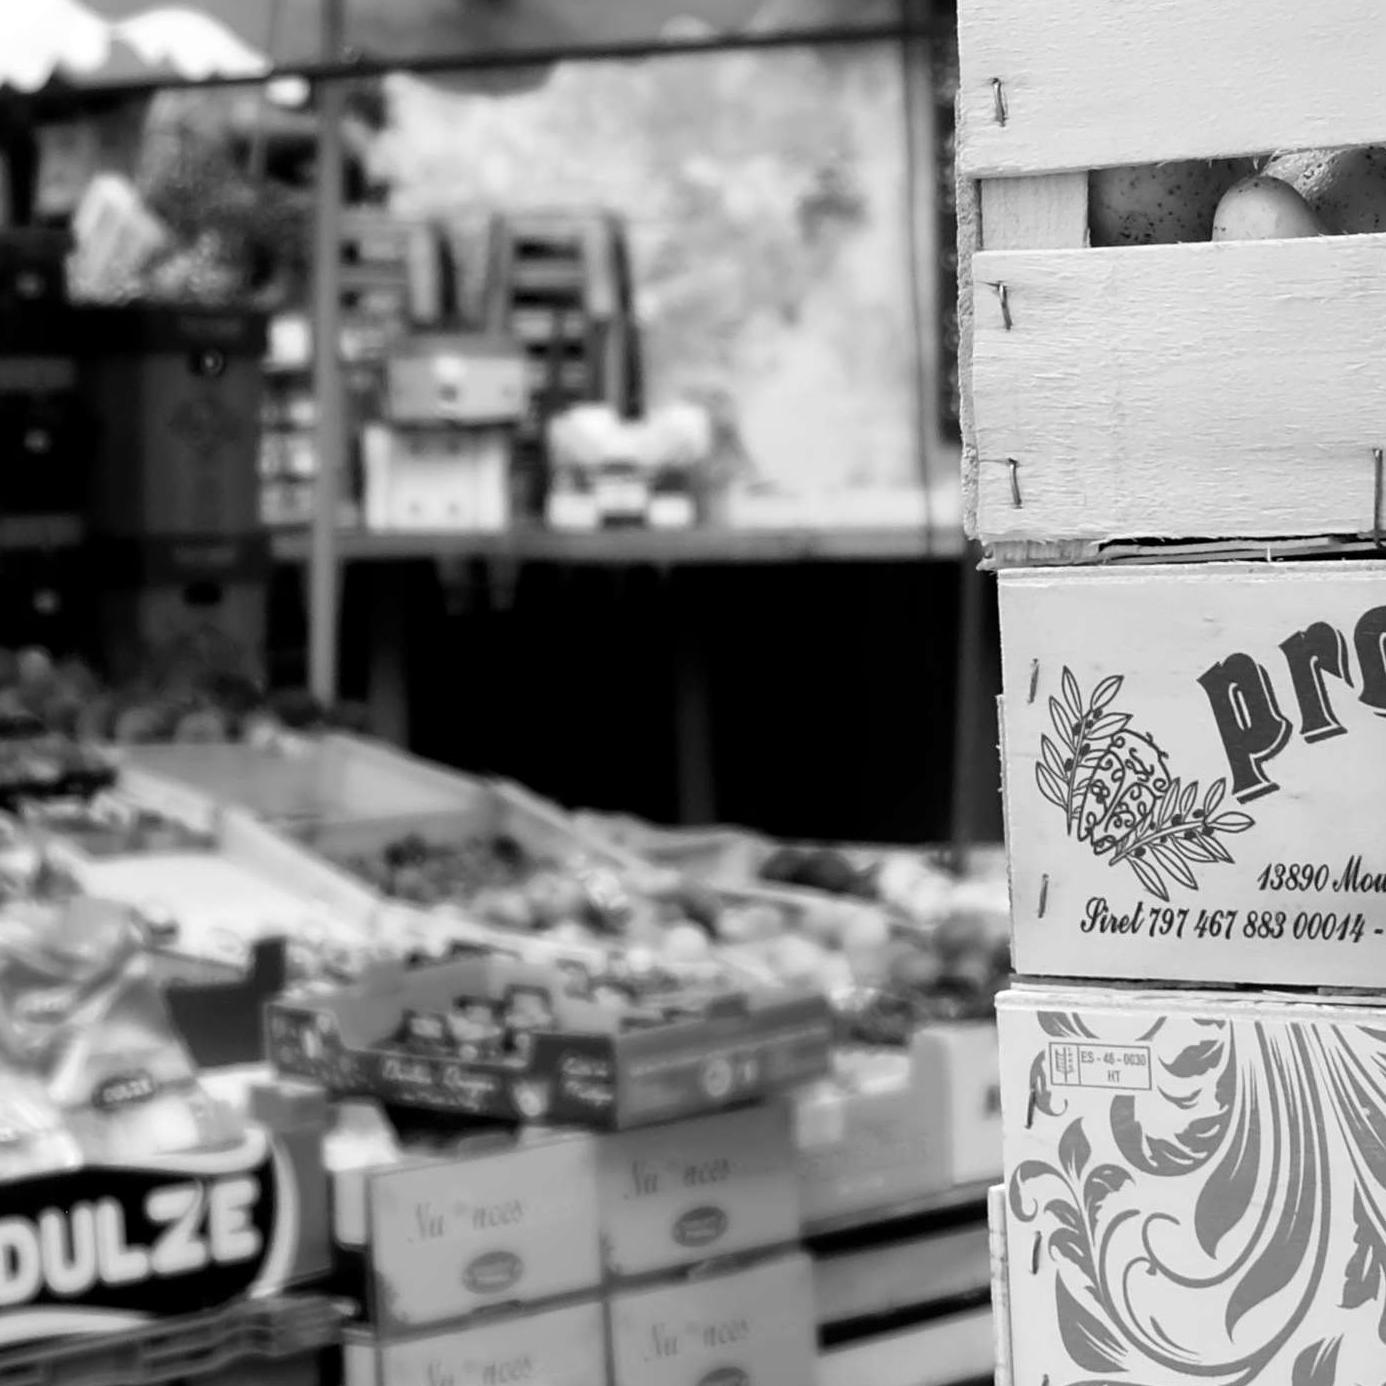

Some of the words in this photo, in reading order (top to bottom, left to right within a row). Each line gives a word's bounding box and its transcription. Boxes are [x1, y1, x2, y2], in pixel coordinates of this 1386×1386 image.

[1258, 861, 1331, 894] 13890
[1080, 897, 1147, 937] Siret
[1148, 908, 1191, 939] 797
[1194, 909, 1237, 939] 467
[1243, 910, 1288, 940] 883
[1293, 910, 1367, 944] 00014
